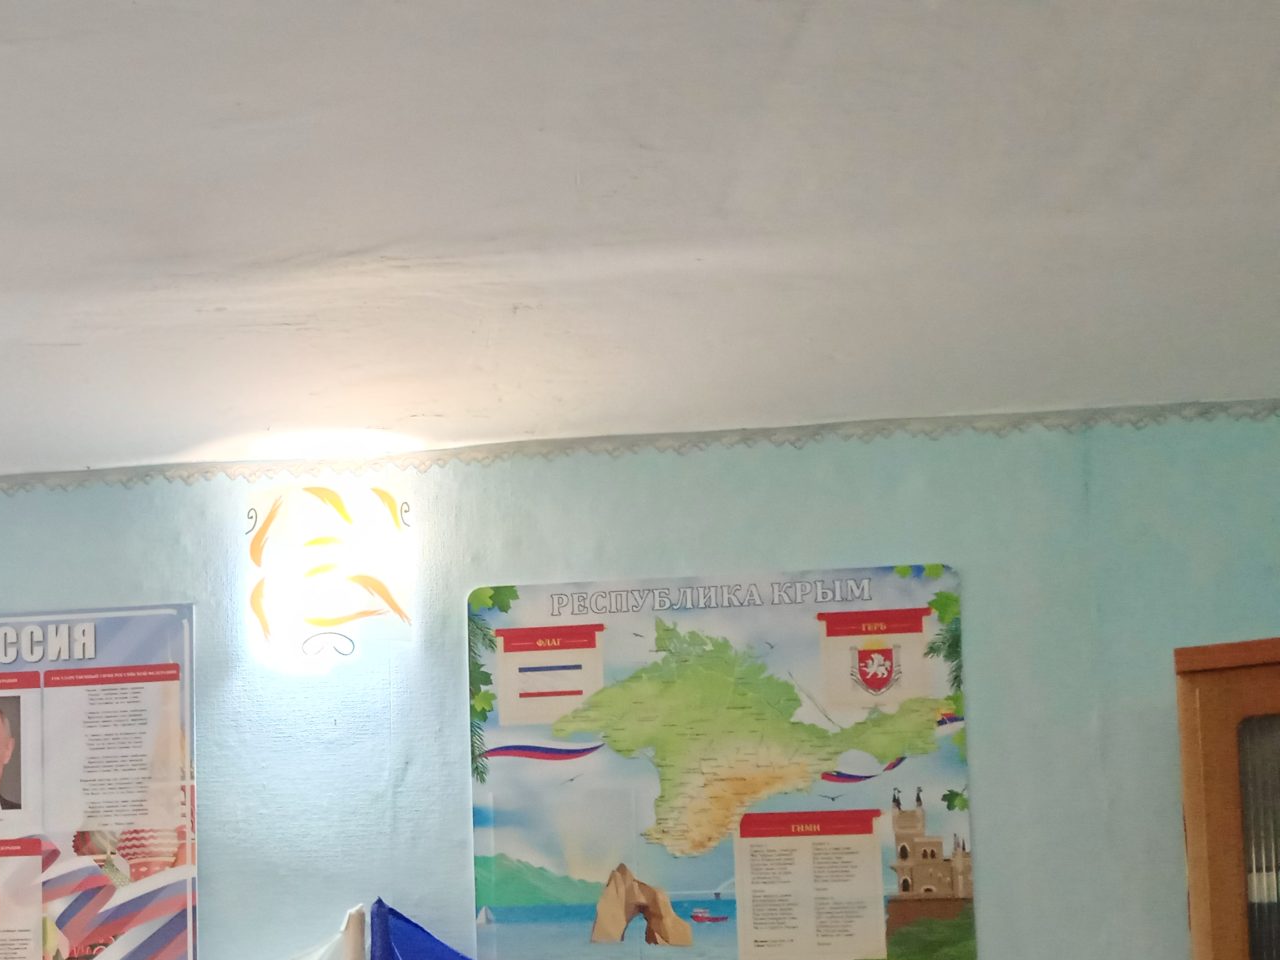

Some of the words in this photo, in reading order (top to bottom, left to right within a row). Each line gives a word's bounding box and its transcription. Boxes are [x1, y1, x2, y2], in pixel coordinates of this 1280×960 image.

[551, 583, 764, 617] РЕСПУБЛИКА
[770, 577, 873, 606] КРЫМ
[536, 638, 562, 647] ФЛАГ
